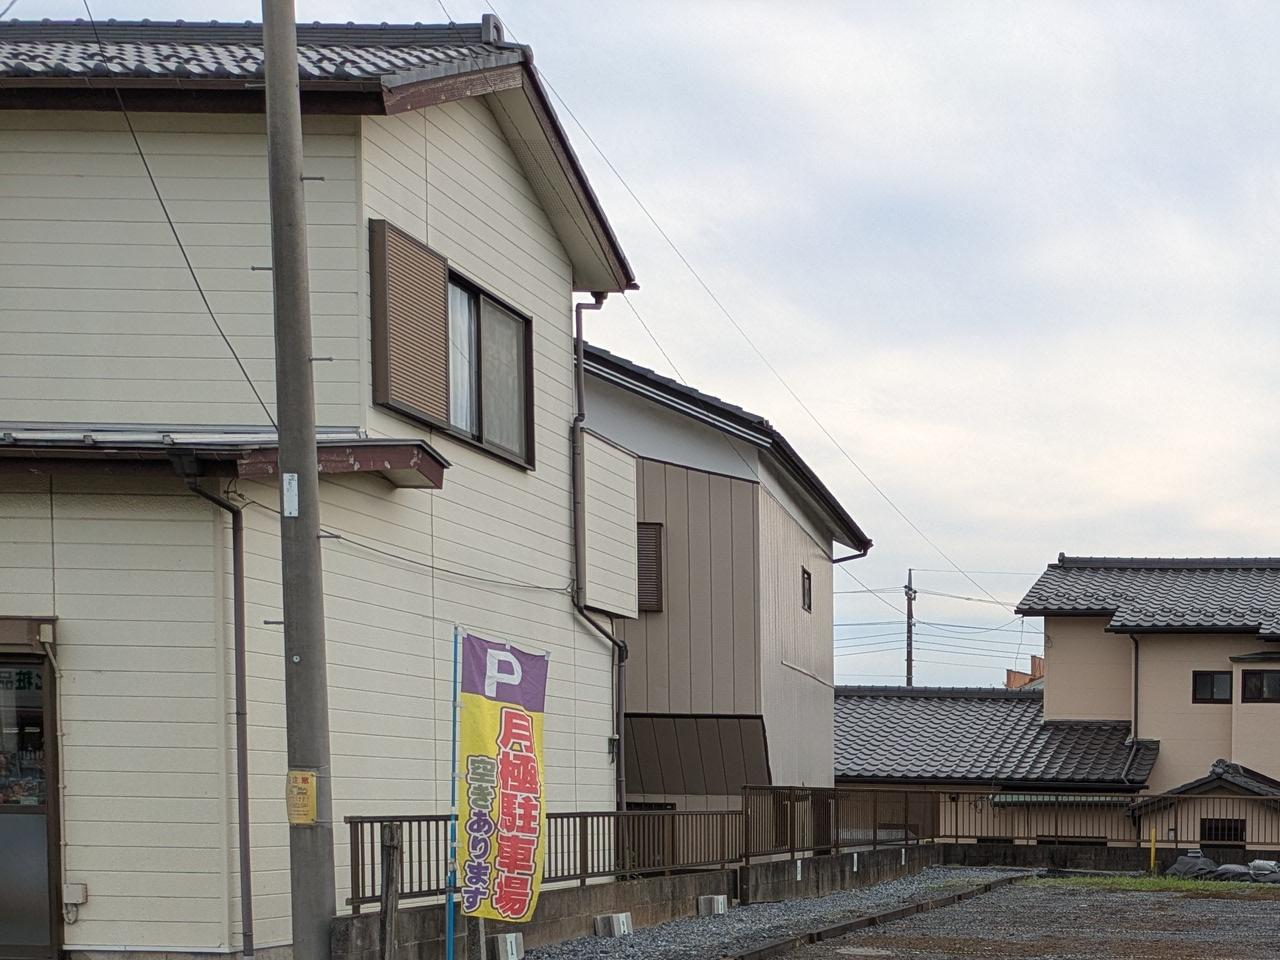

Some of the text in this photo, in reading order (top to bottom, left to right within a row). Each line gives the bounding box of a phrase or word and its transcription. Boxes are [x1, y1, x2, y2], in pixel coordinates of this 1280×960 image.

[484, 648, 522, 698] P
[462, 756, 497, 912] 空きあります
[494, 708, 540, 918] 月極駐車場
